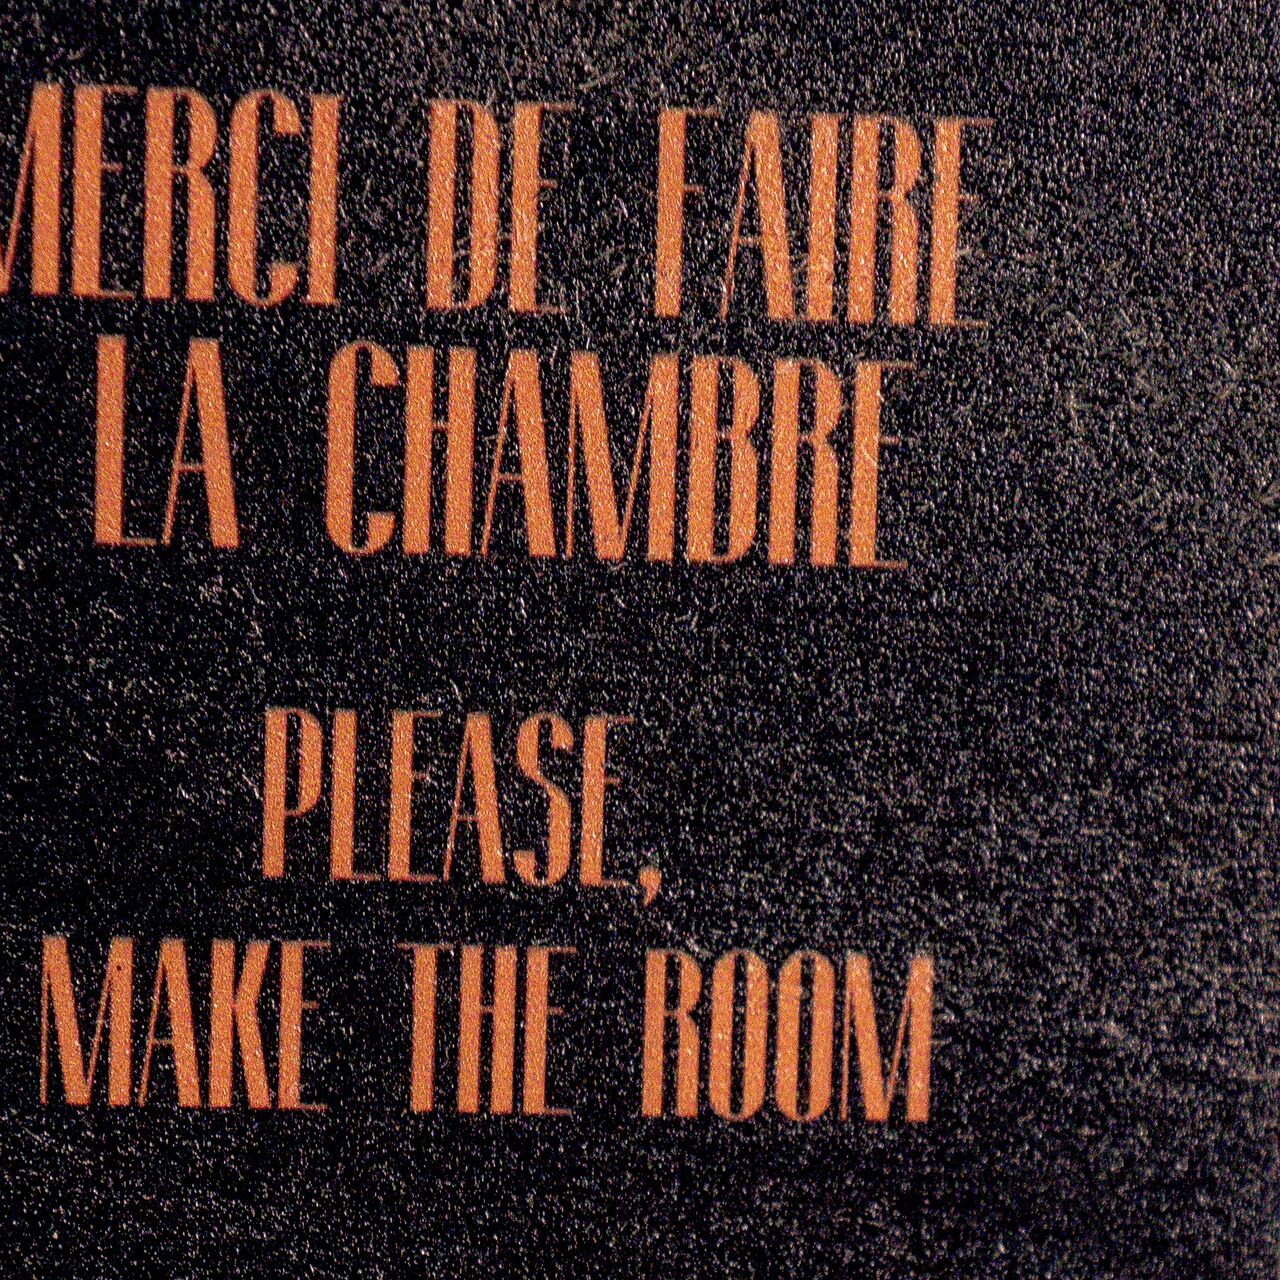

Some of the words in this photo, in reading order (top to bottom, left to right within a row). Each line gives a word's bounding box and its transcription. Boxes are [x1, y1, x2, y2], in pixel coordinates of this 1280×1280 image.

[426, 99, 572, 314] DE
[654, 107, 989, 329] FAIRE
[94, 336, 240, 549] LA
[325, 342, 912, 569] CHAMBRE
[262, 708, 662, 905] PLEASE,
[40, 937, 328, 1111] MAKE
[400, 942, 575, 1115] THE
[641, 950, 935, 1123] ROOM
